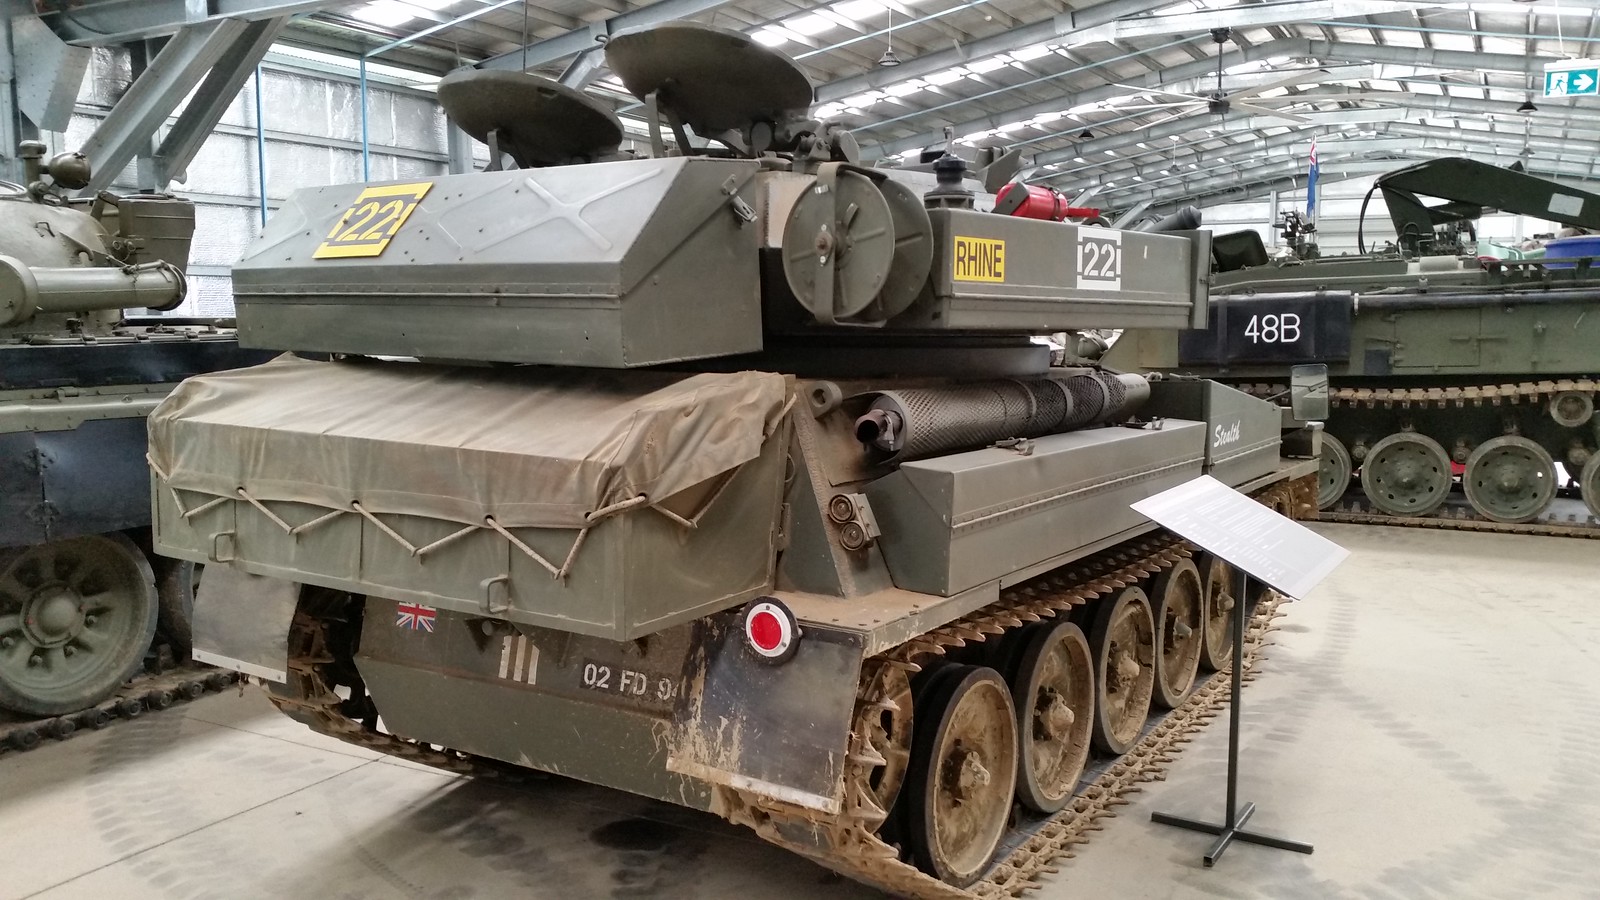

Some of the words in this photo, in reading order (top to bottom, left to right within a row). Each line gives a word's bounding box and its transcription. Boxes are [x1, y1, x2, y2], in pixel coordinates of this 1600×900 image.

[956, 240, 1003, 278] RHINE
[1244, 313, 1301, 344] 48B
[1213, 419, 1241, 448] Stealth
[583, 663, 611, 689] 02
[619, 669, 647, 696] FD
